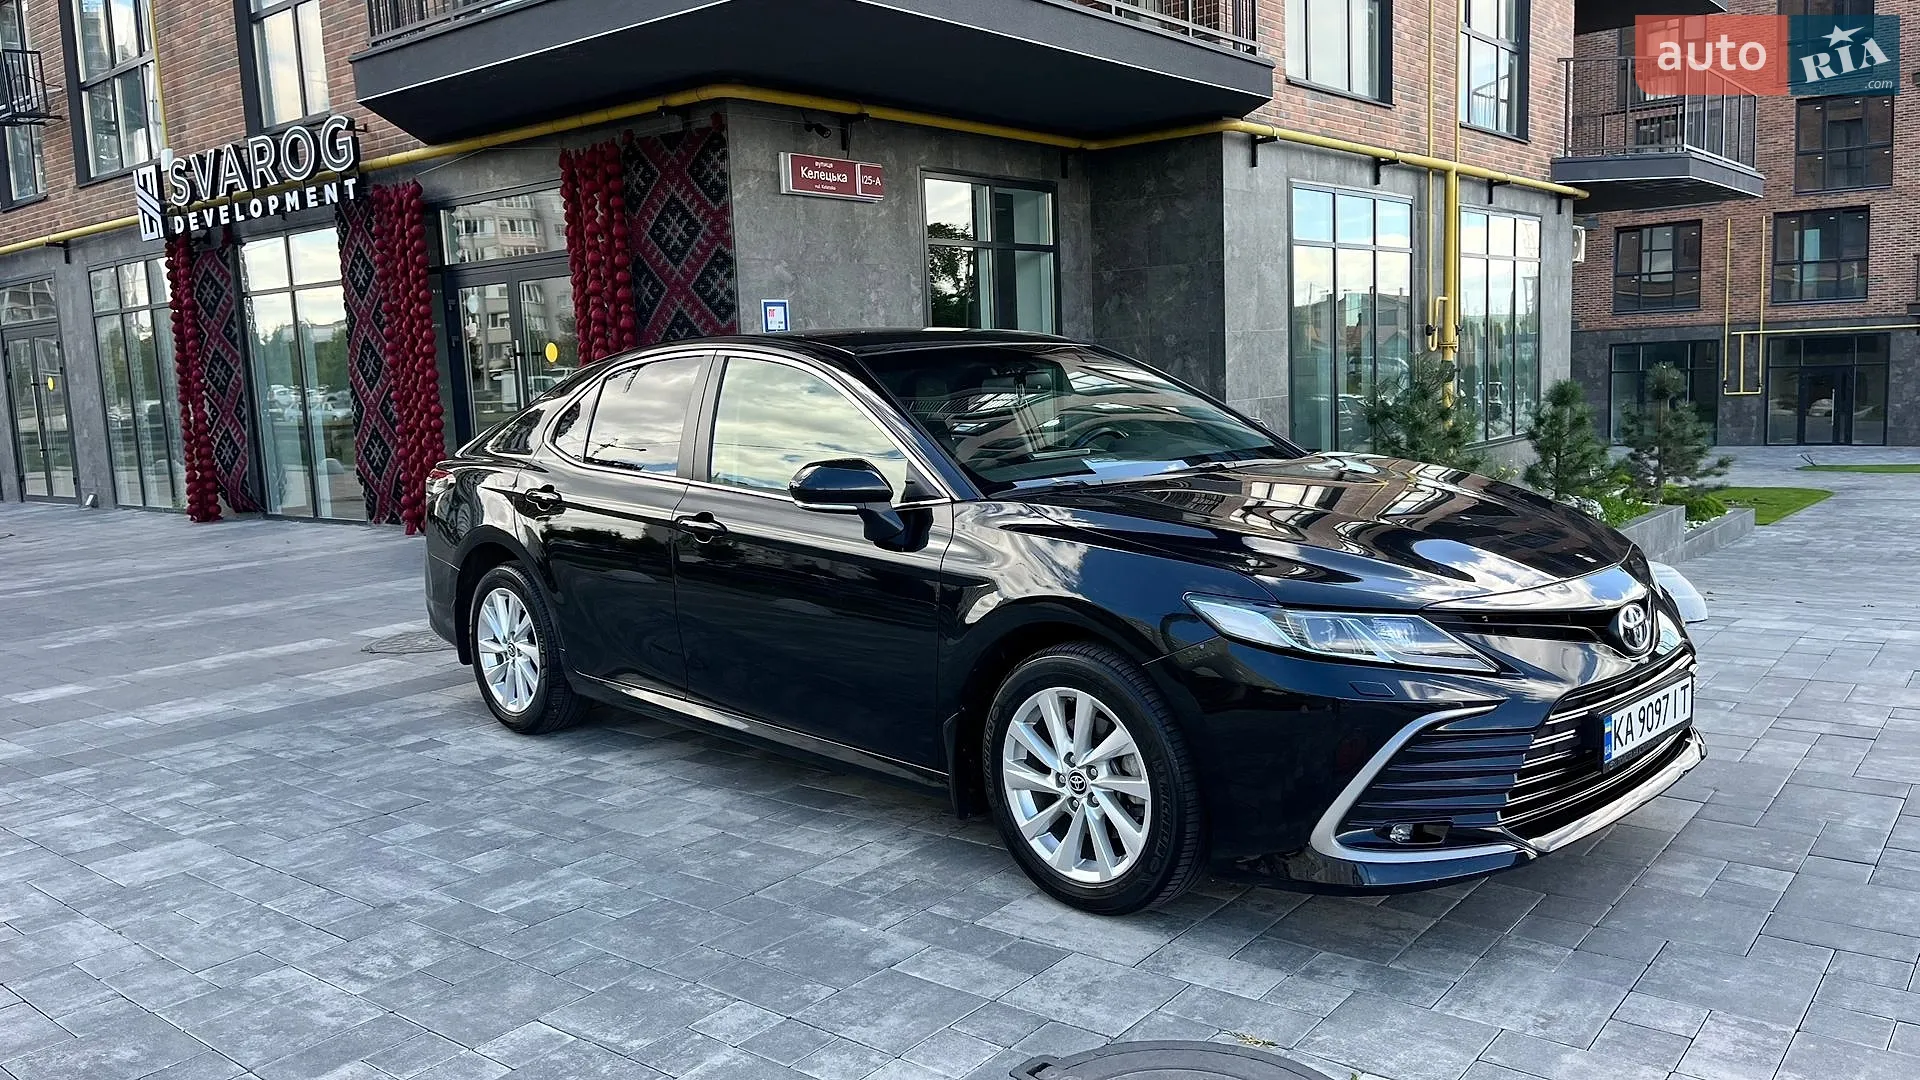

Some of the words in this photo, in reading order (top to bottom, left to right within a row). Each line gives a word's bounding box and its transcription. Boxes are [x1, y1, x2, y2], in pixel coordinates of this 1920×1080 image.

[169, 115, 356, 207] SVAROG
[800, 166, 848, 183] Келецька
[173, 177, 358, 235] DEVELOPMENT
[1613, 711, 1635, 751] KA
[1638, 693, 1670, 739] 9097
[1673, 683, 1690, 719] IT
